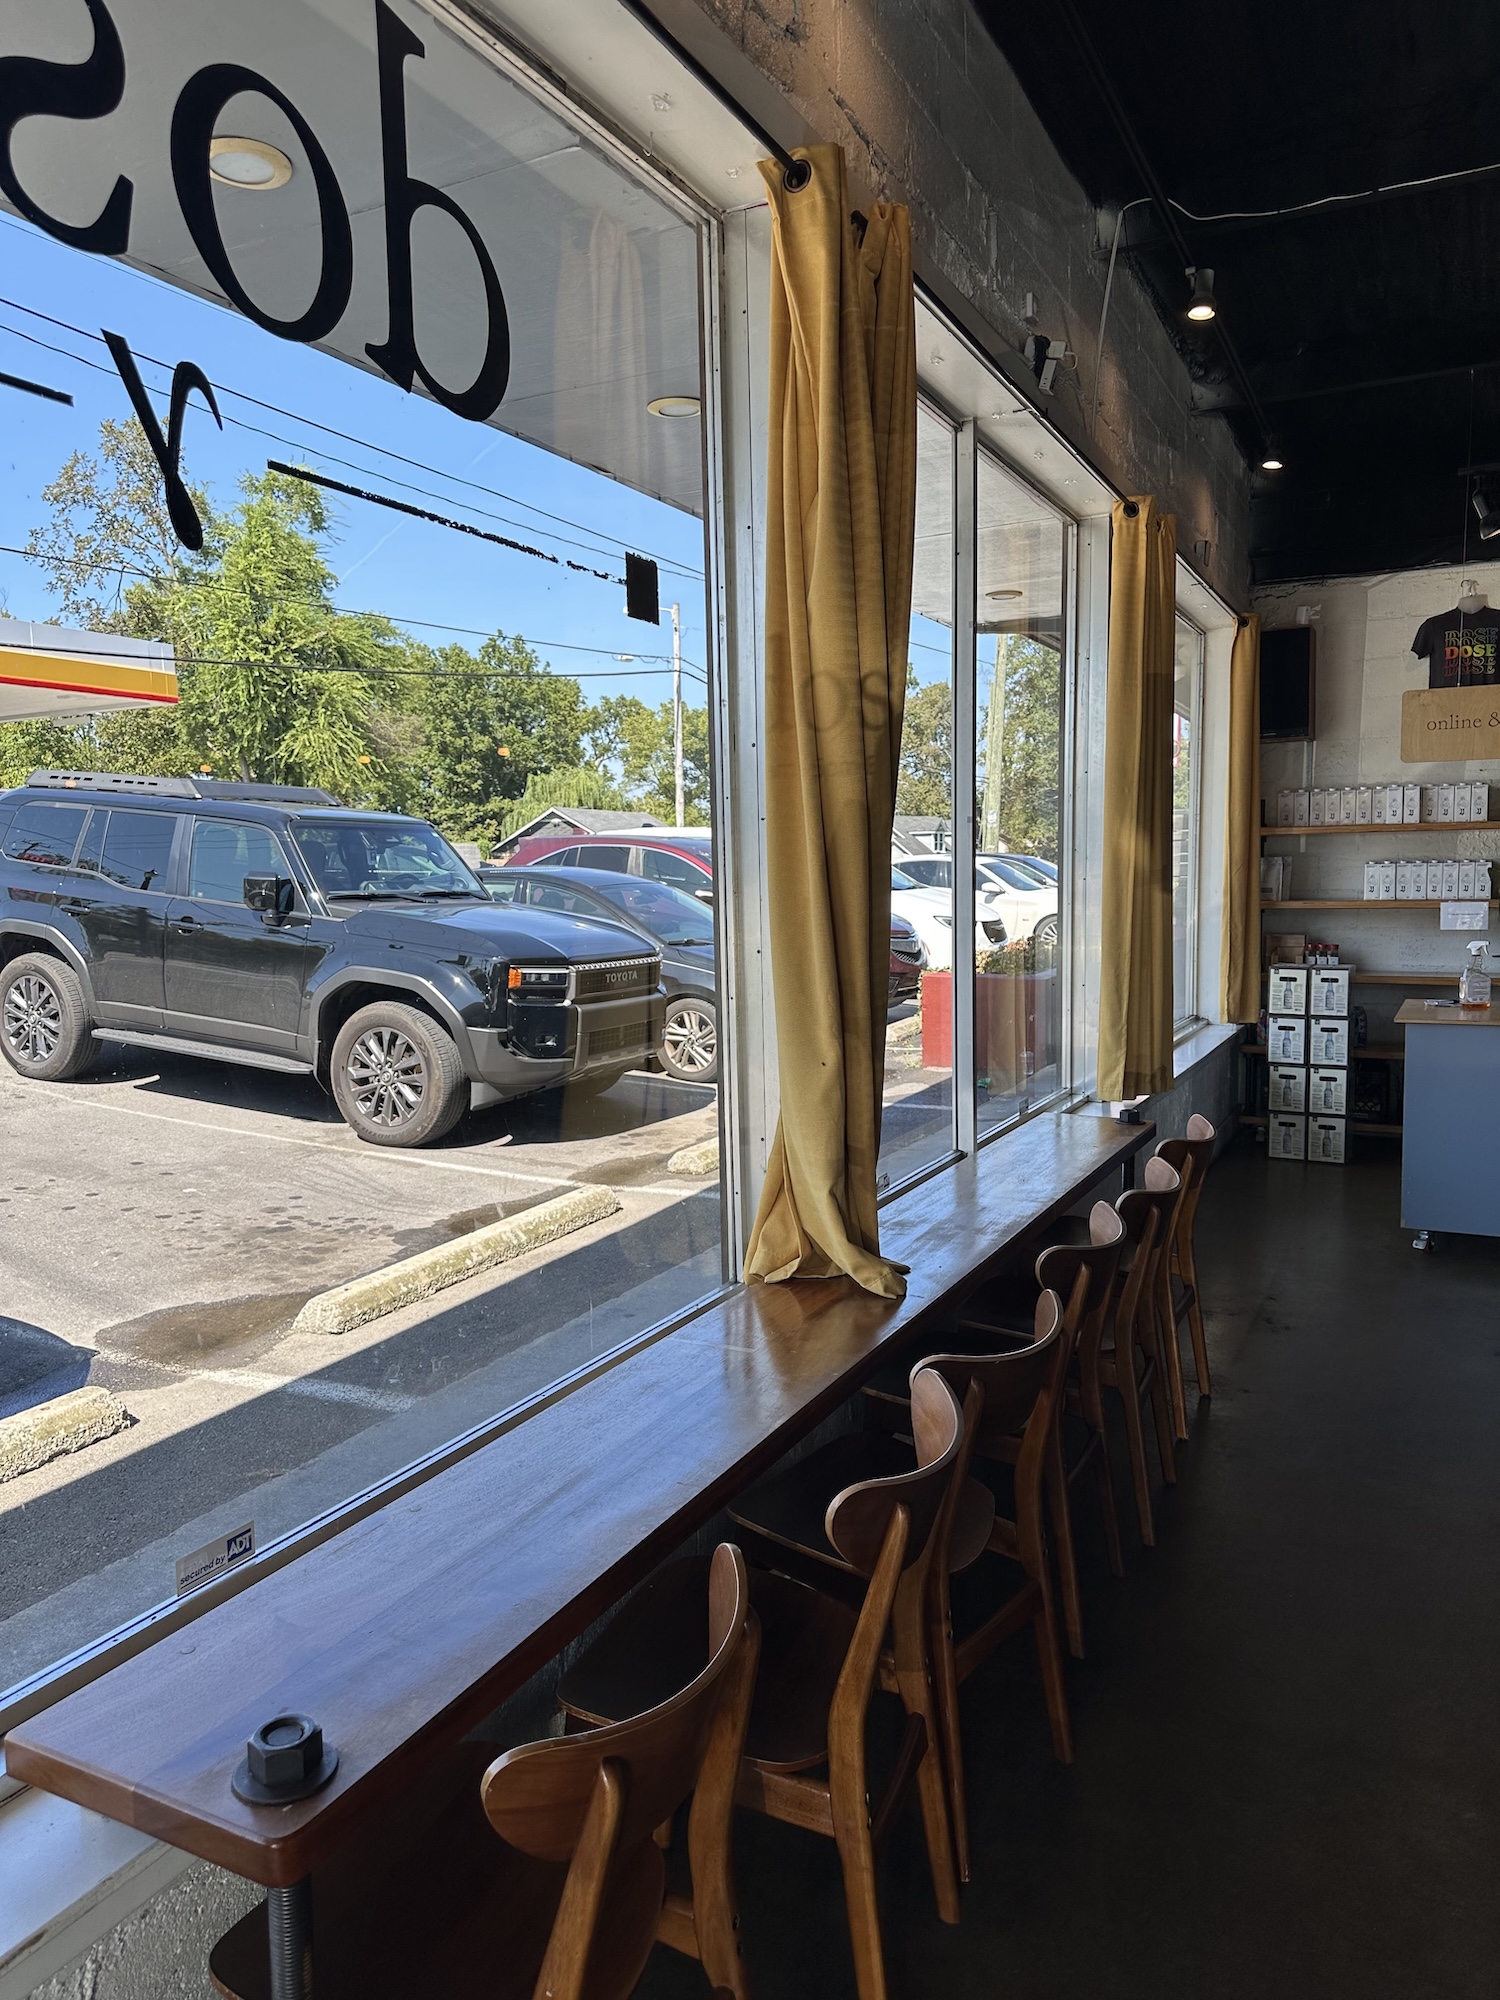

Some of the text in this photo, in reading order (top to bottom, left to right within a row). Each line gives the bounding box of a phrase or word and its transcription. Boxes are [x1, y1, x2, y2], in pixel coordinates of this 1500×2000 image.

[1445, 644, 1497, 659] DOSE
[1427, 711, 1500, 731] online &
[605, 970, 638, 983] TOYOTA
[180, 1535, 251, 1585] secured by ADT
